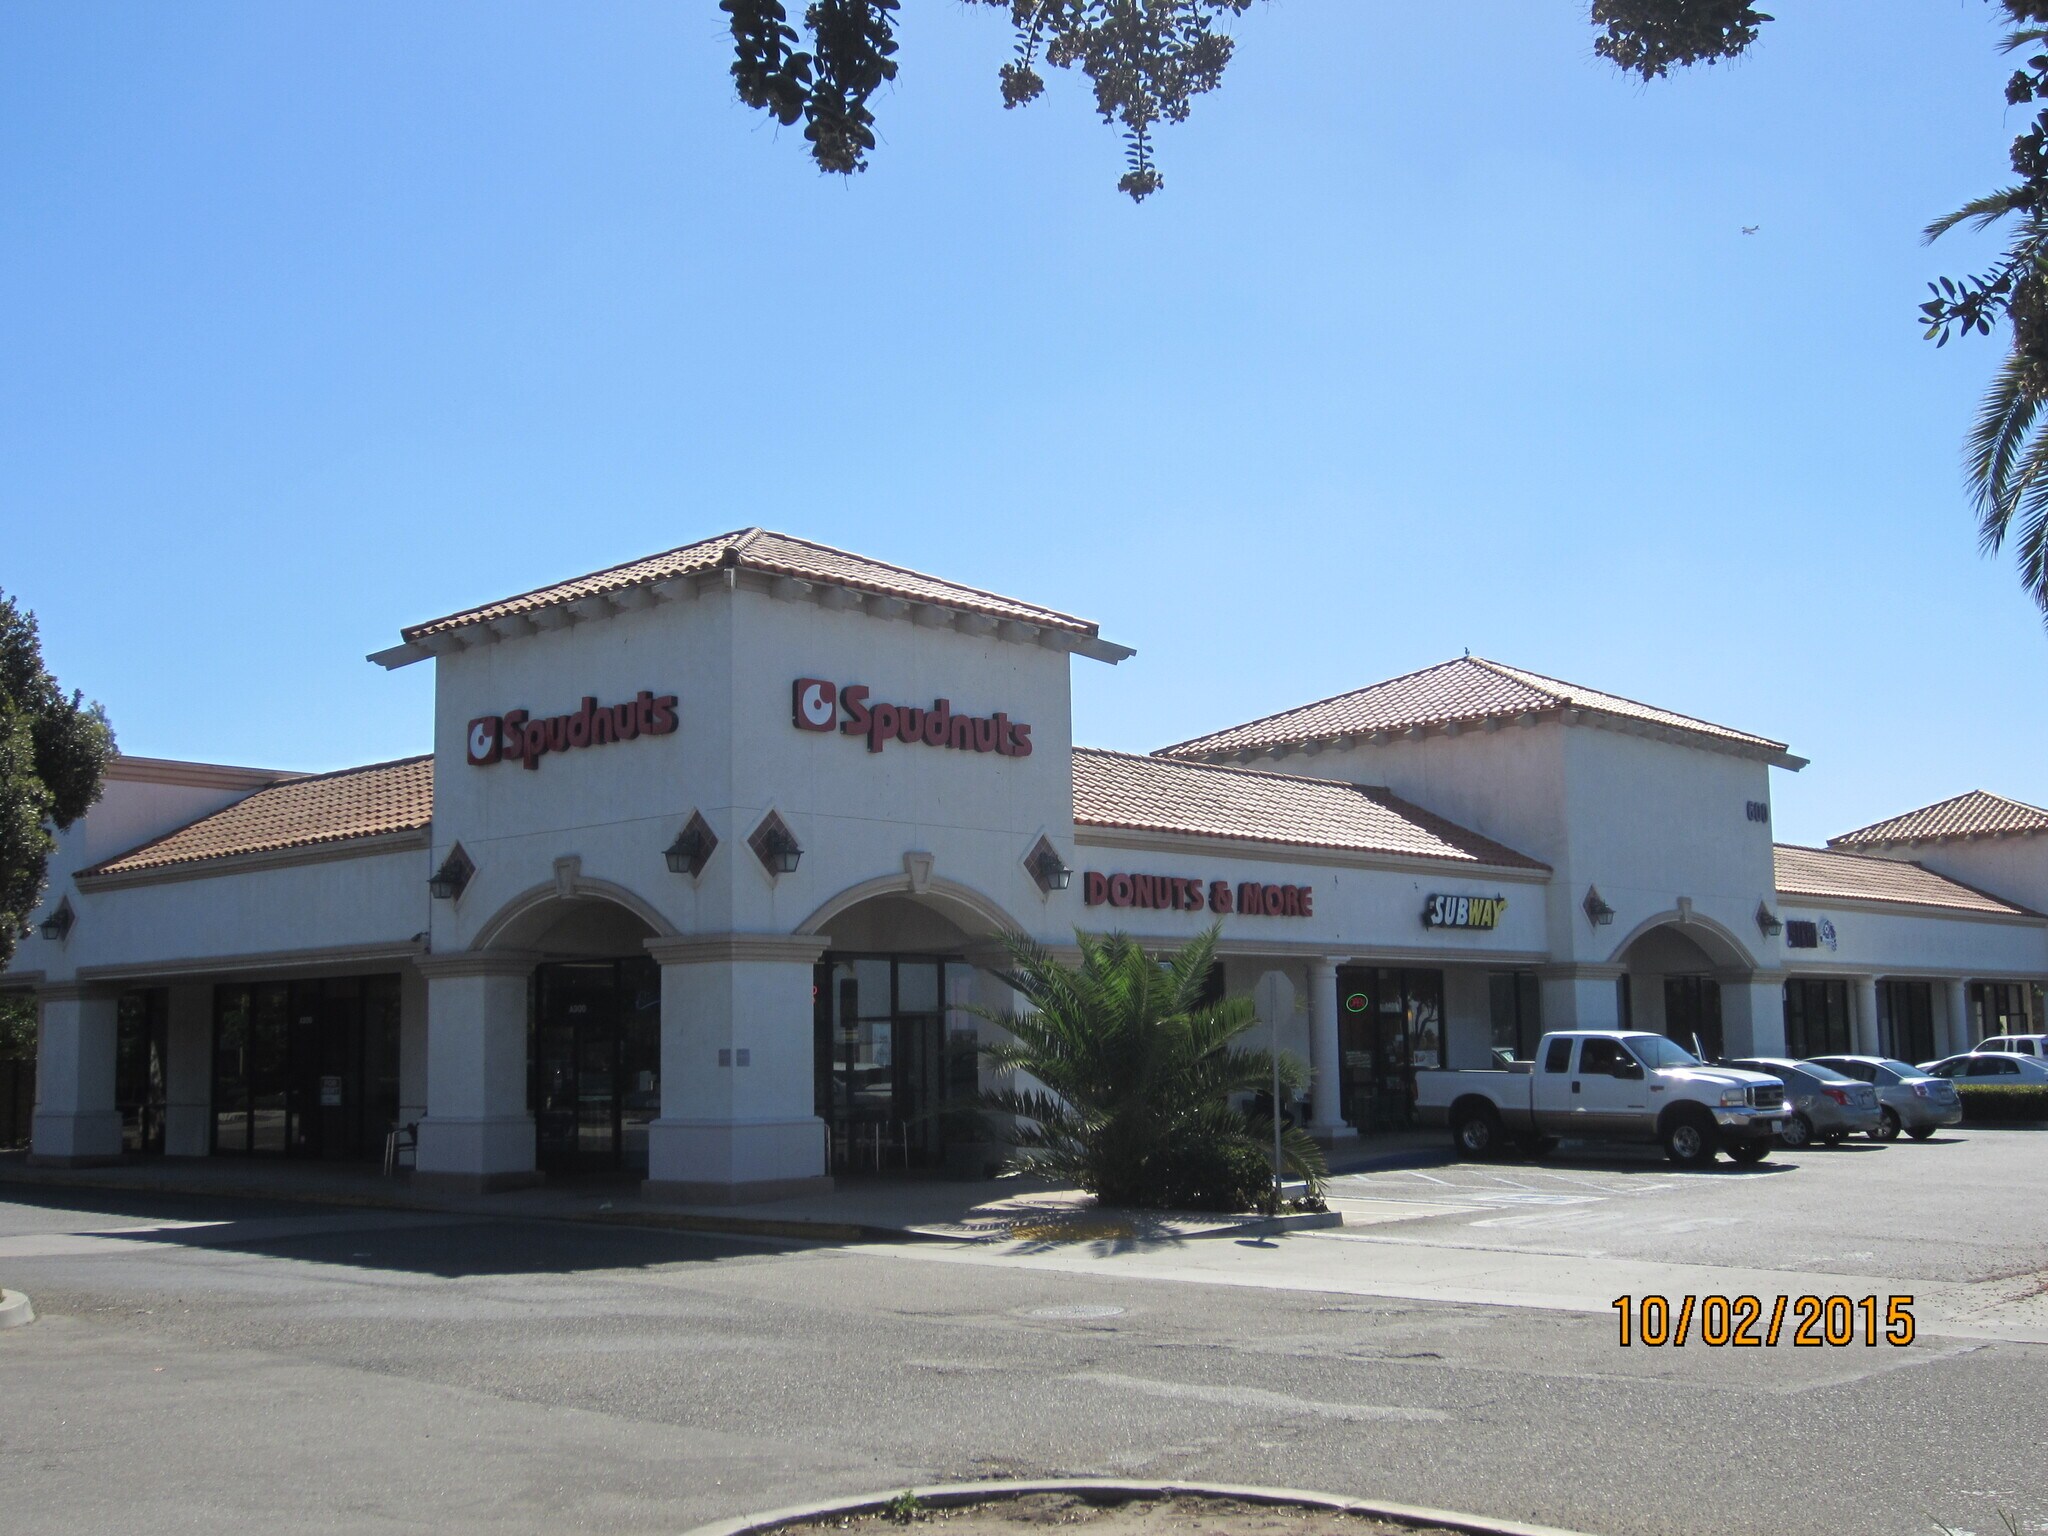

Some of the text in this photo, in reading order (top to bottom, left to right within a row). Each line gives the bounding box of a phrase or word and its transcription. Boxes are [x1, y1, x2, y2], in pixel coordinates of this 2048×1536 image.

[502, 690, 680, 771] Spudnuts
[840, 685, 1033, 758] Spudnuts
[1084, 871, 1313, 917] DONUTS & MORE
[1429, 894, 1509, 928] SUBWAY
